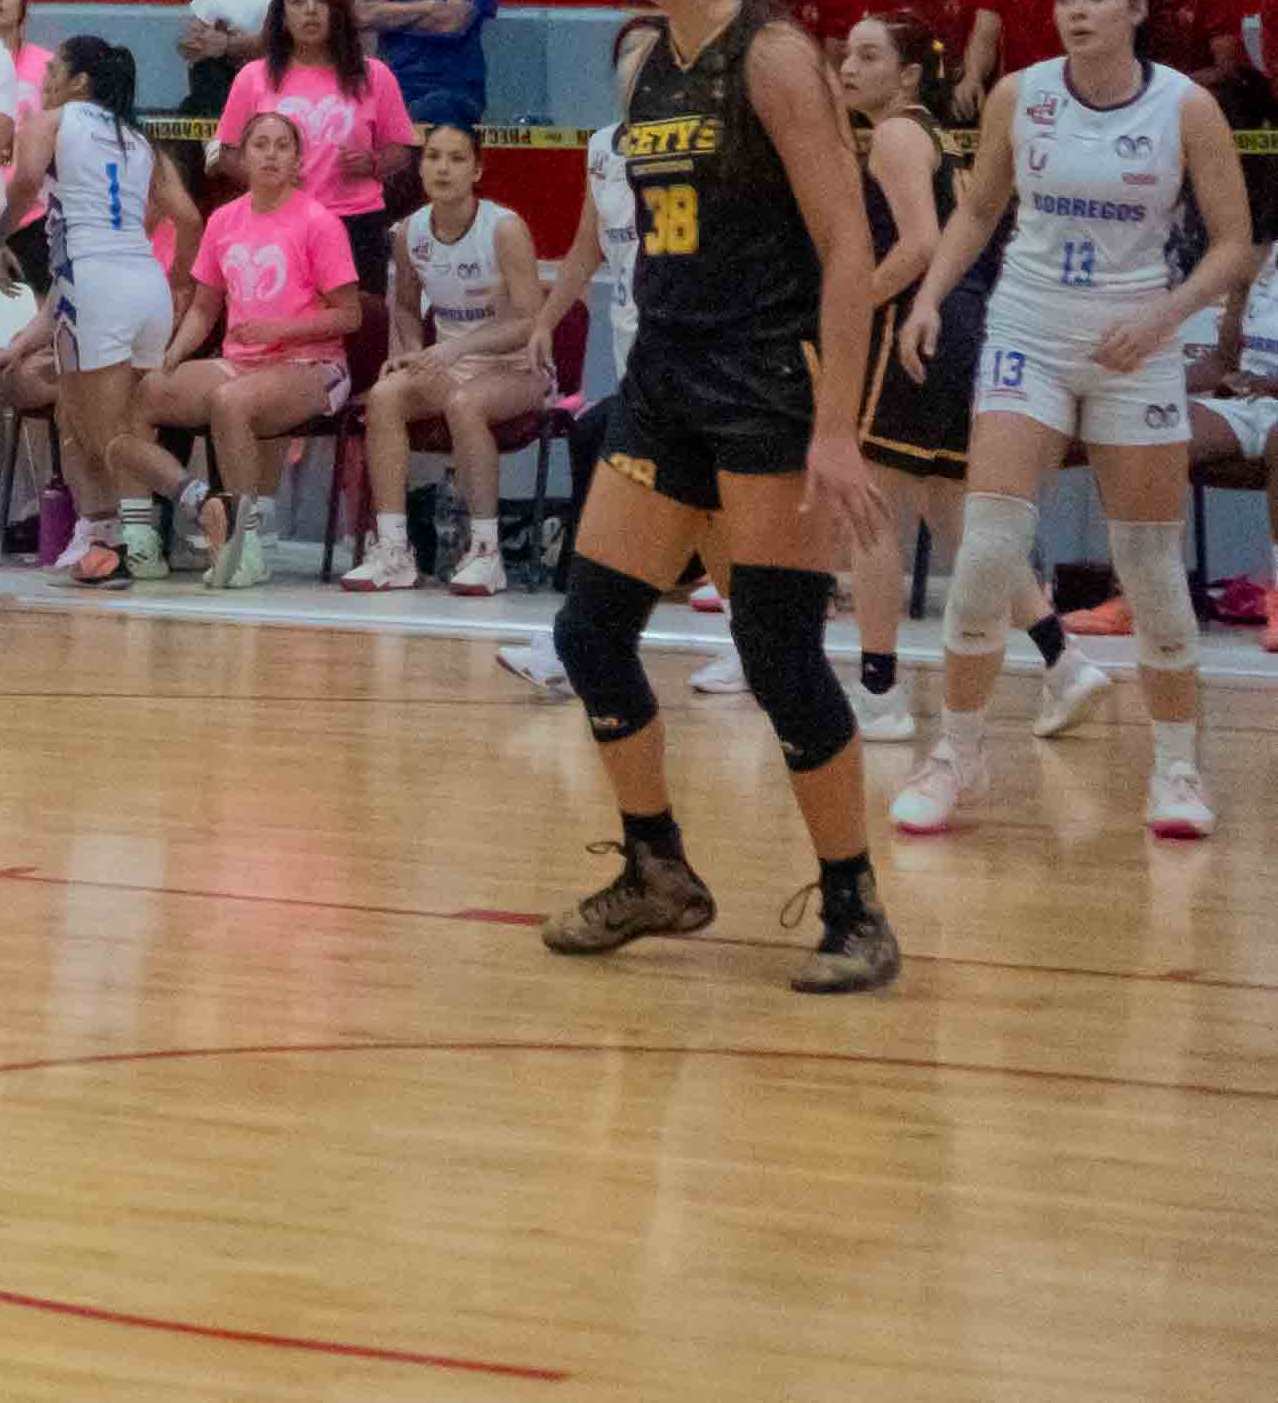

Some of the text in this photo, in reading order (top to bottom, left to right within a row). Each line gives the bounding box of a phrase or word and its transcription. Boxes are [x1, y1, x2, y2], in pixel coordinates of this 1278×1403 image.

[106, 163, 123, 231] 1
[642, 183, 700, 256] 38
[994, 350, 1027, 387] 13
